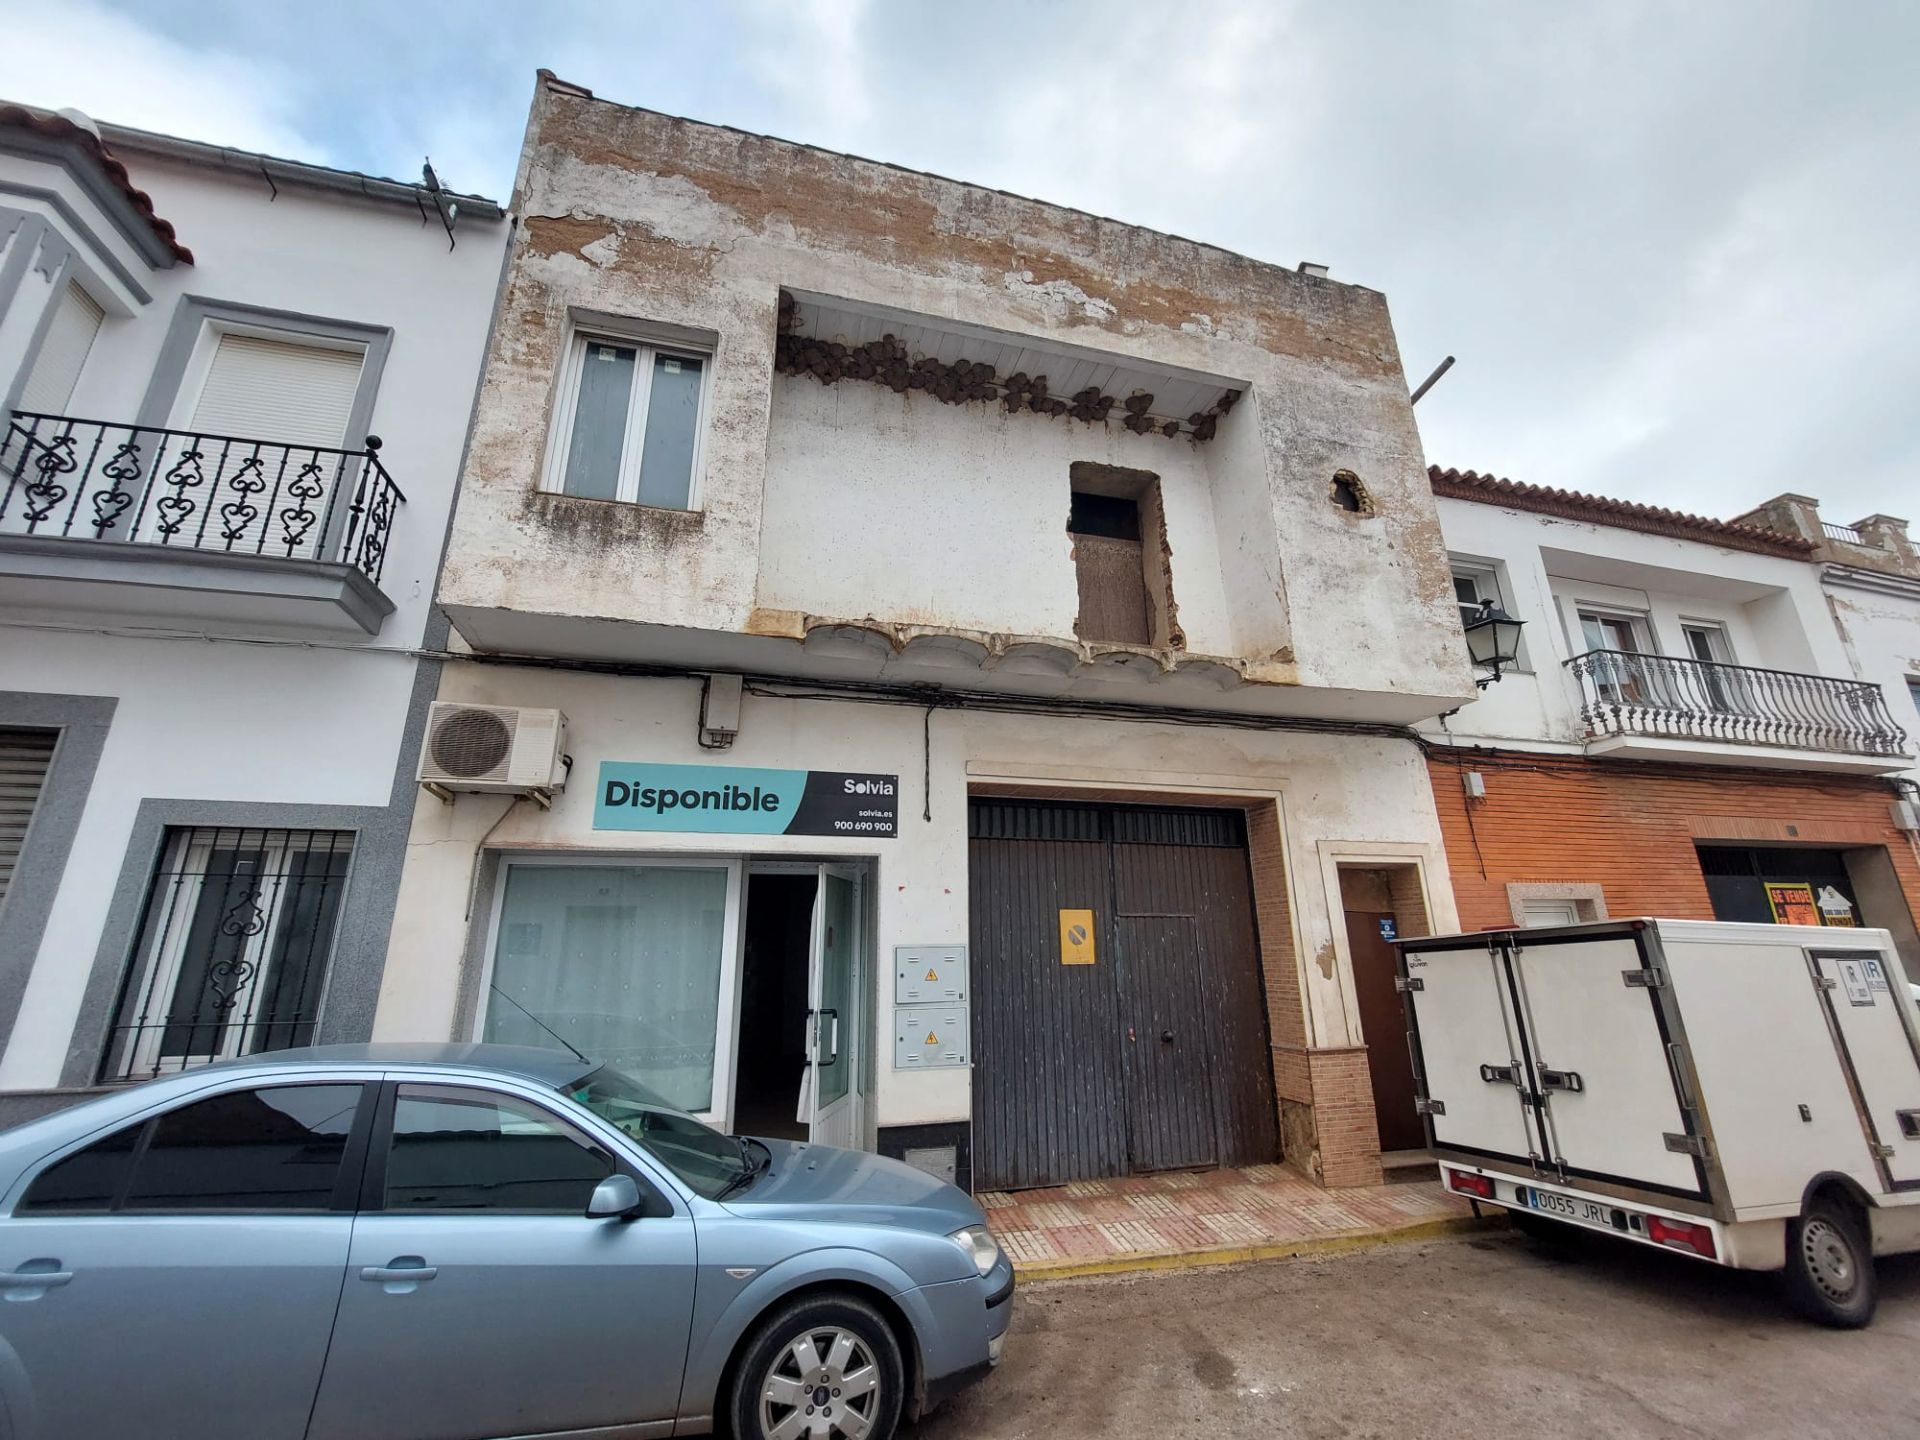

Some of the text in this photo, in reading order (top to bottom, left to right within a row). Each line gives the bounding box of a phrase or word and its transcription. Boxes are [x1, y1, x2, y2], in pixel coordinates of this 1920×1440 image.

[844, 779, 894, 796] Solvia
[605, 781, 780, 814] Disponible
[858, 809, 893, 818] solvia.es
[834, 821, 893, 832] 900 690 900
[1772, 889, 1811, 903] SE VENDE
[1862, 961, 1881, 978] IR
[1539, 1193, 1610, 1225] 0055 JRL
